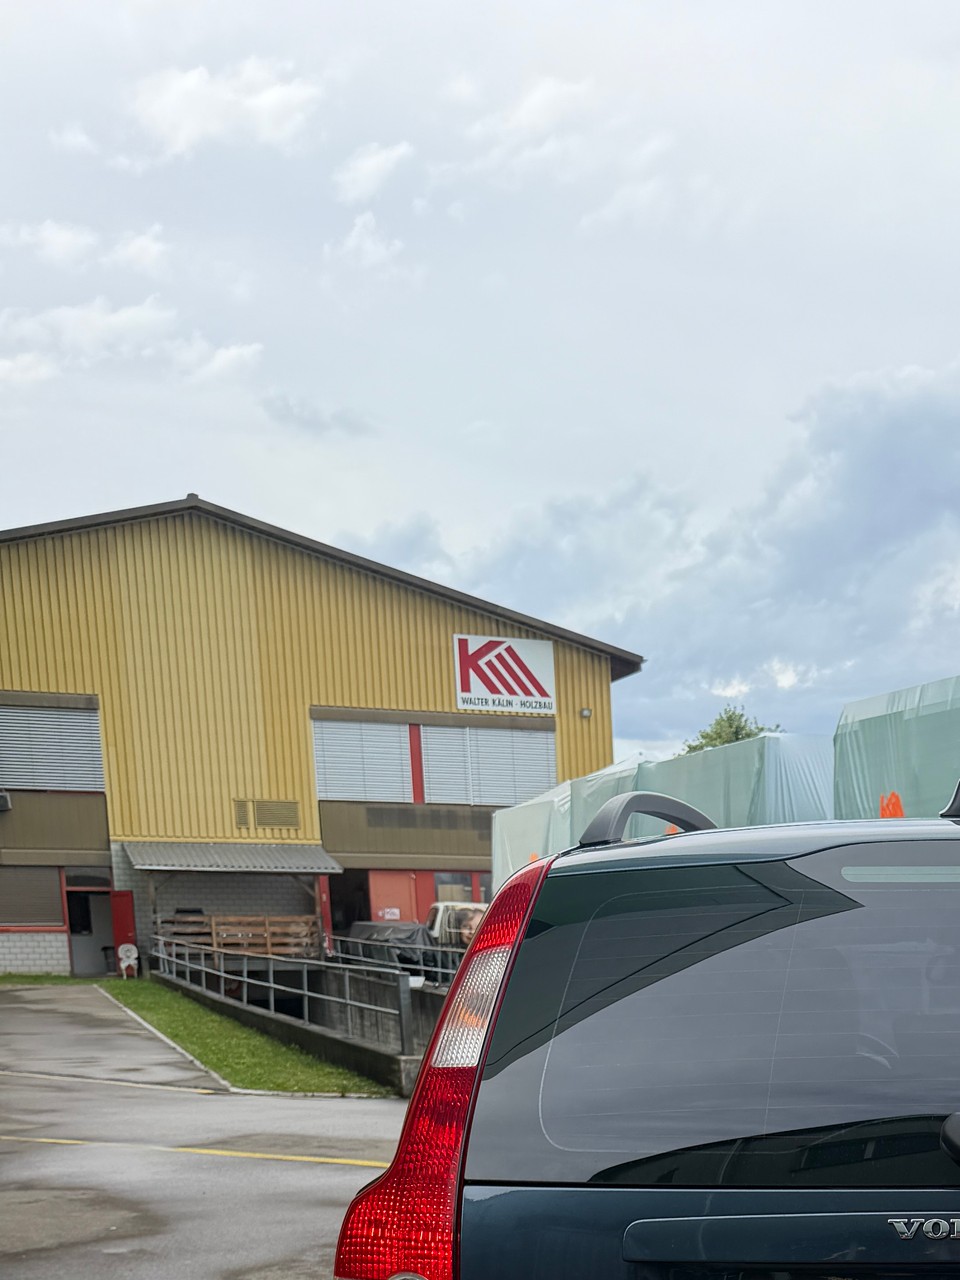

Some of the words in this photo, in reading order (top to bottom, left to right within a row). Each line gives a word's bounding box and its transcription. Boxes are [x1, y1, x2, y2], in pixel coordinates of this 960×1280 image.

[461, 696, 490, 707] WALTER
[492, 697, 514, 708] KÄLIN
[520, 700, 553, 711] HOLZBAU
